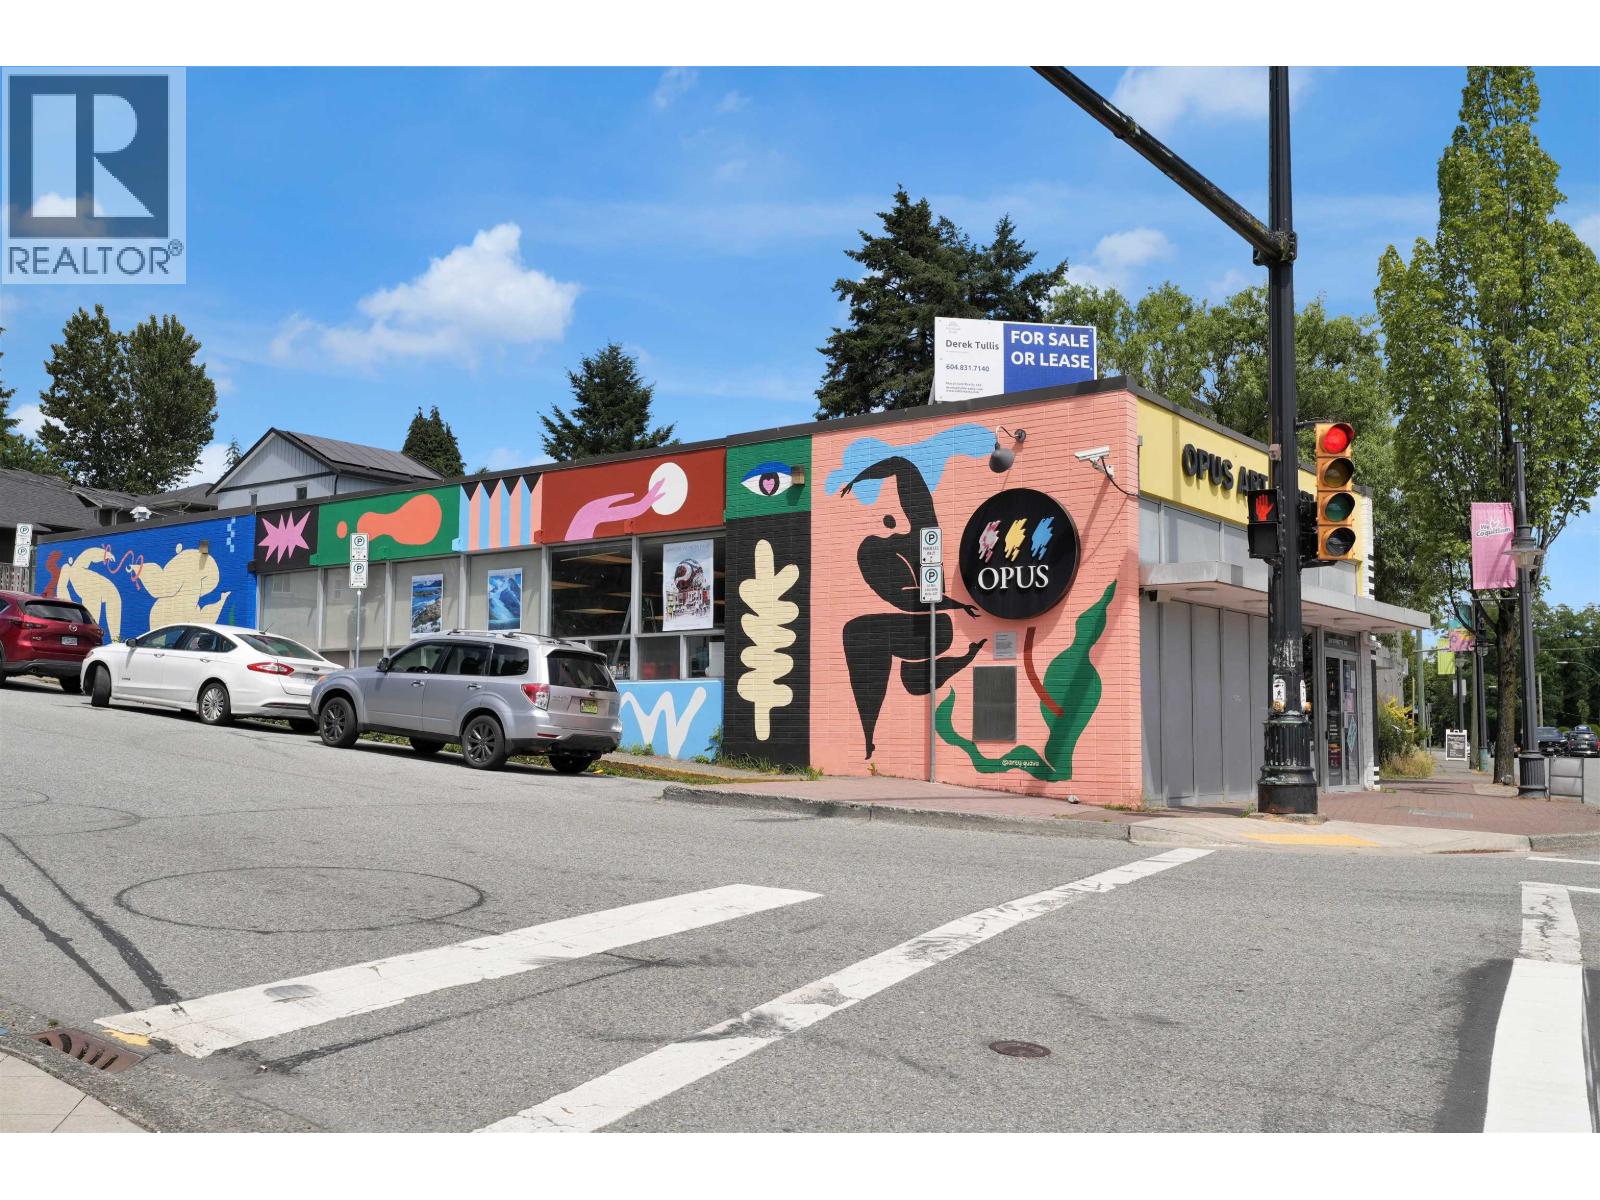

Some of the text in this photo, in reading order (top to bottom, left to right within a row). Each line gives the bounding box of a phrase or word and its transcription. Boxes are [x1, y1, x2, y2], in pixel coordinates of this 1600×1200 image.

[945, 339, 1000, 350] Derek Tullis
[1011, 330, 1090, 348] FOR SALE
[945, 363, 990, 372] 604.831.7140
[1011, 351, 1090, 369] OR LEASE
[1182, 443, 1234, 490] OPUS
[1476, 527, 1511, 537] Coquitlam
[977, 564, 1049, 590] OPUS
